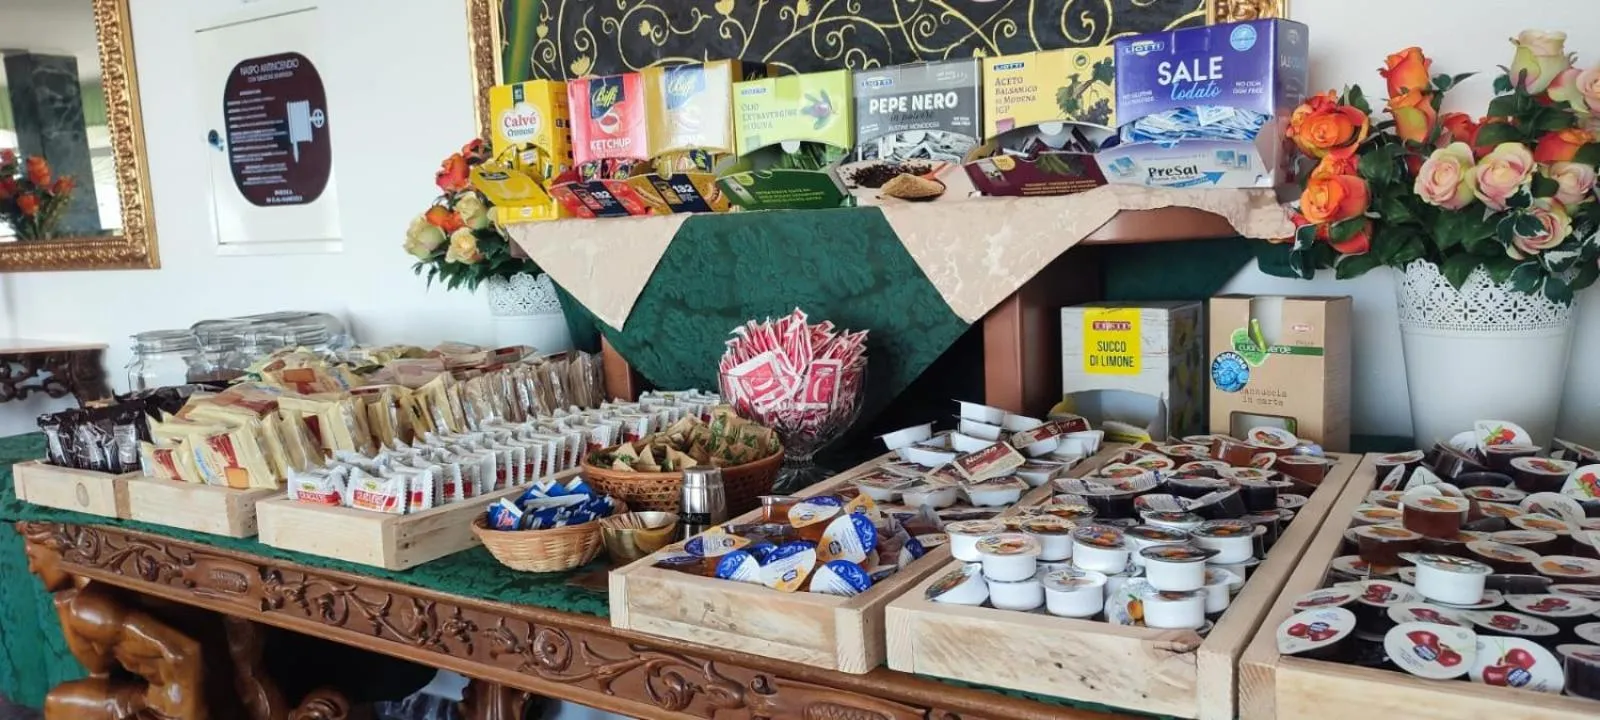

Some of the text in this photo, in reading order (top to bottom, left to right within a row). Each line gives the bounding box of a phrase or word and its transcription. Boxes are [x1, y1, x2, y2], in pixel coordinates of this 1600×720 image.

[1157, 55, 1224, 86] SALE
[995, 77, 1024, 87] ACETO
[995, 86, 1038, 96] BALSAMICO
[869, 91, 958, 114] PEPE NERO
[504, 112, 537, 129] Calvé
[590, 138, 632, 150] KETCHUP
[1148, 164, 1198, 177] PreSal
[673, 184, 695, 193] 132
[1097, 340, 1127, 353] SUCCO
[1090, 355, 1135, 368] DI LIMONE
